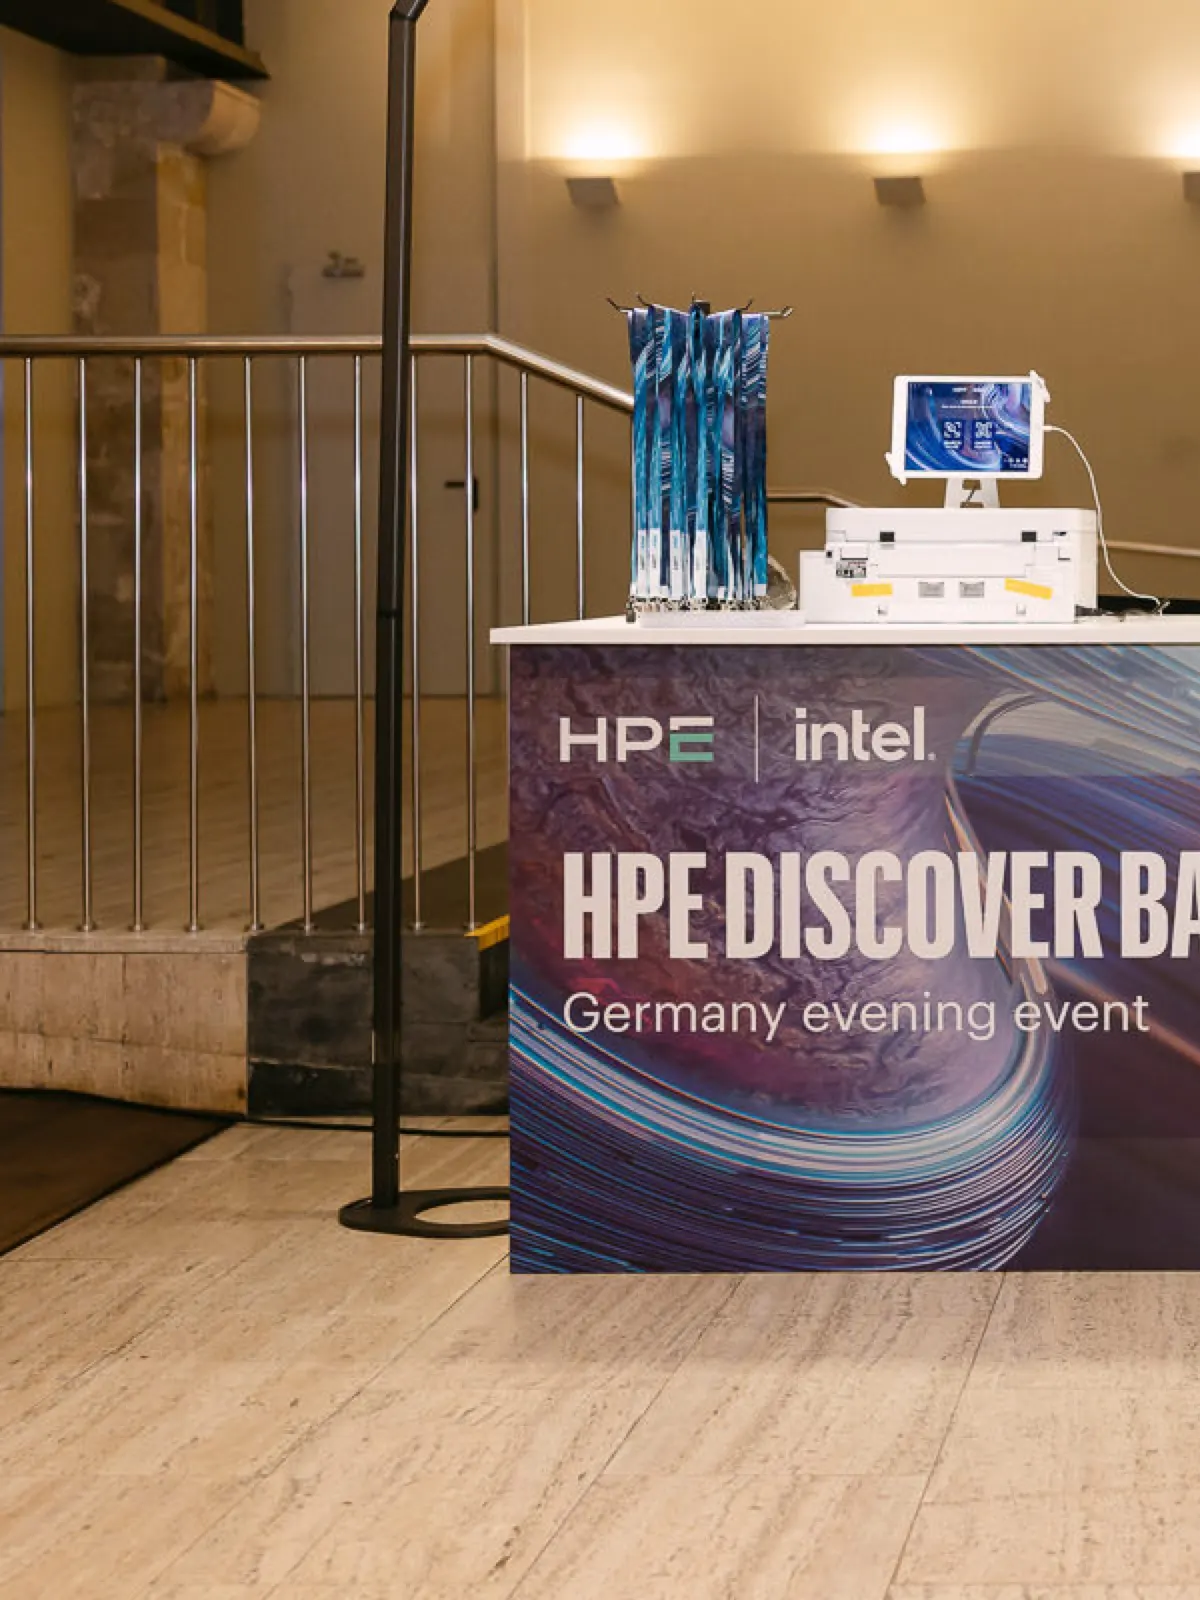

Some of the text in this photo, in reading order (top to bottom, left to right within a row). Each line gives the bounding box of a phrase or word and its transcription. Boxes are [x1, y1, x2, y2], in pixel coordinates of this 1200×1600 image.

[559, 717, 714, 762] HPE
[563, 852, 708, 959] HPE
[725, 850, 1103, 959] DISCOVER
[563, 991, 1150, 1042] Germany evening event
